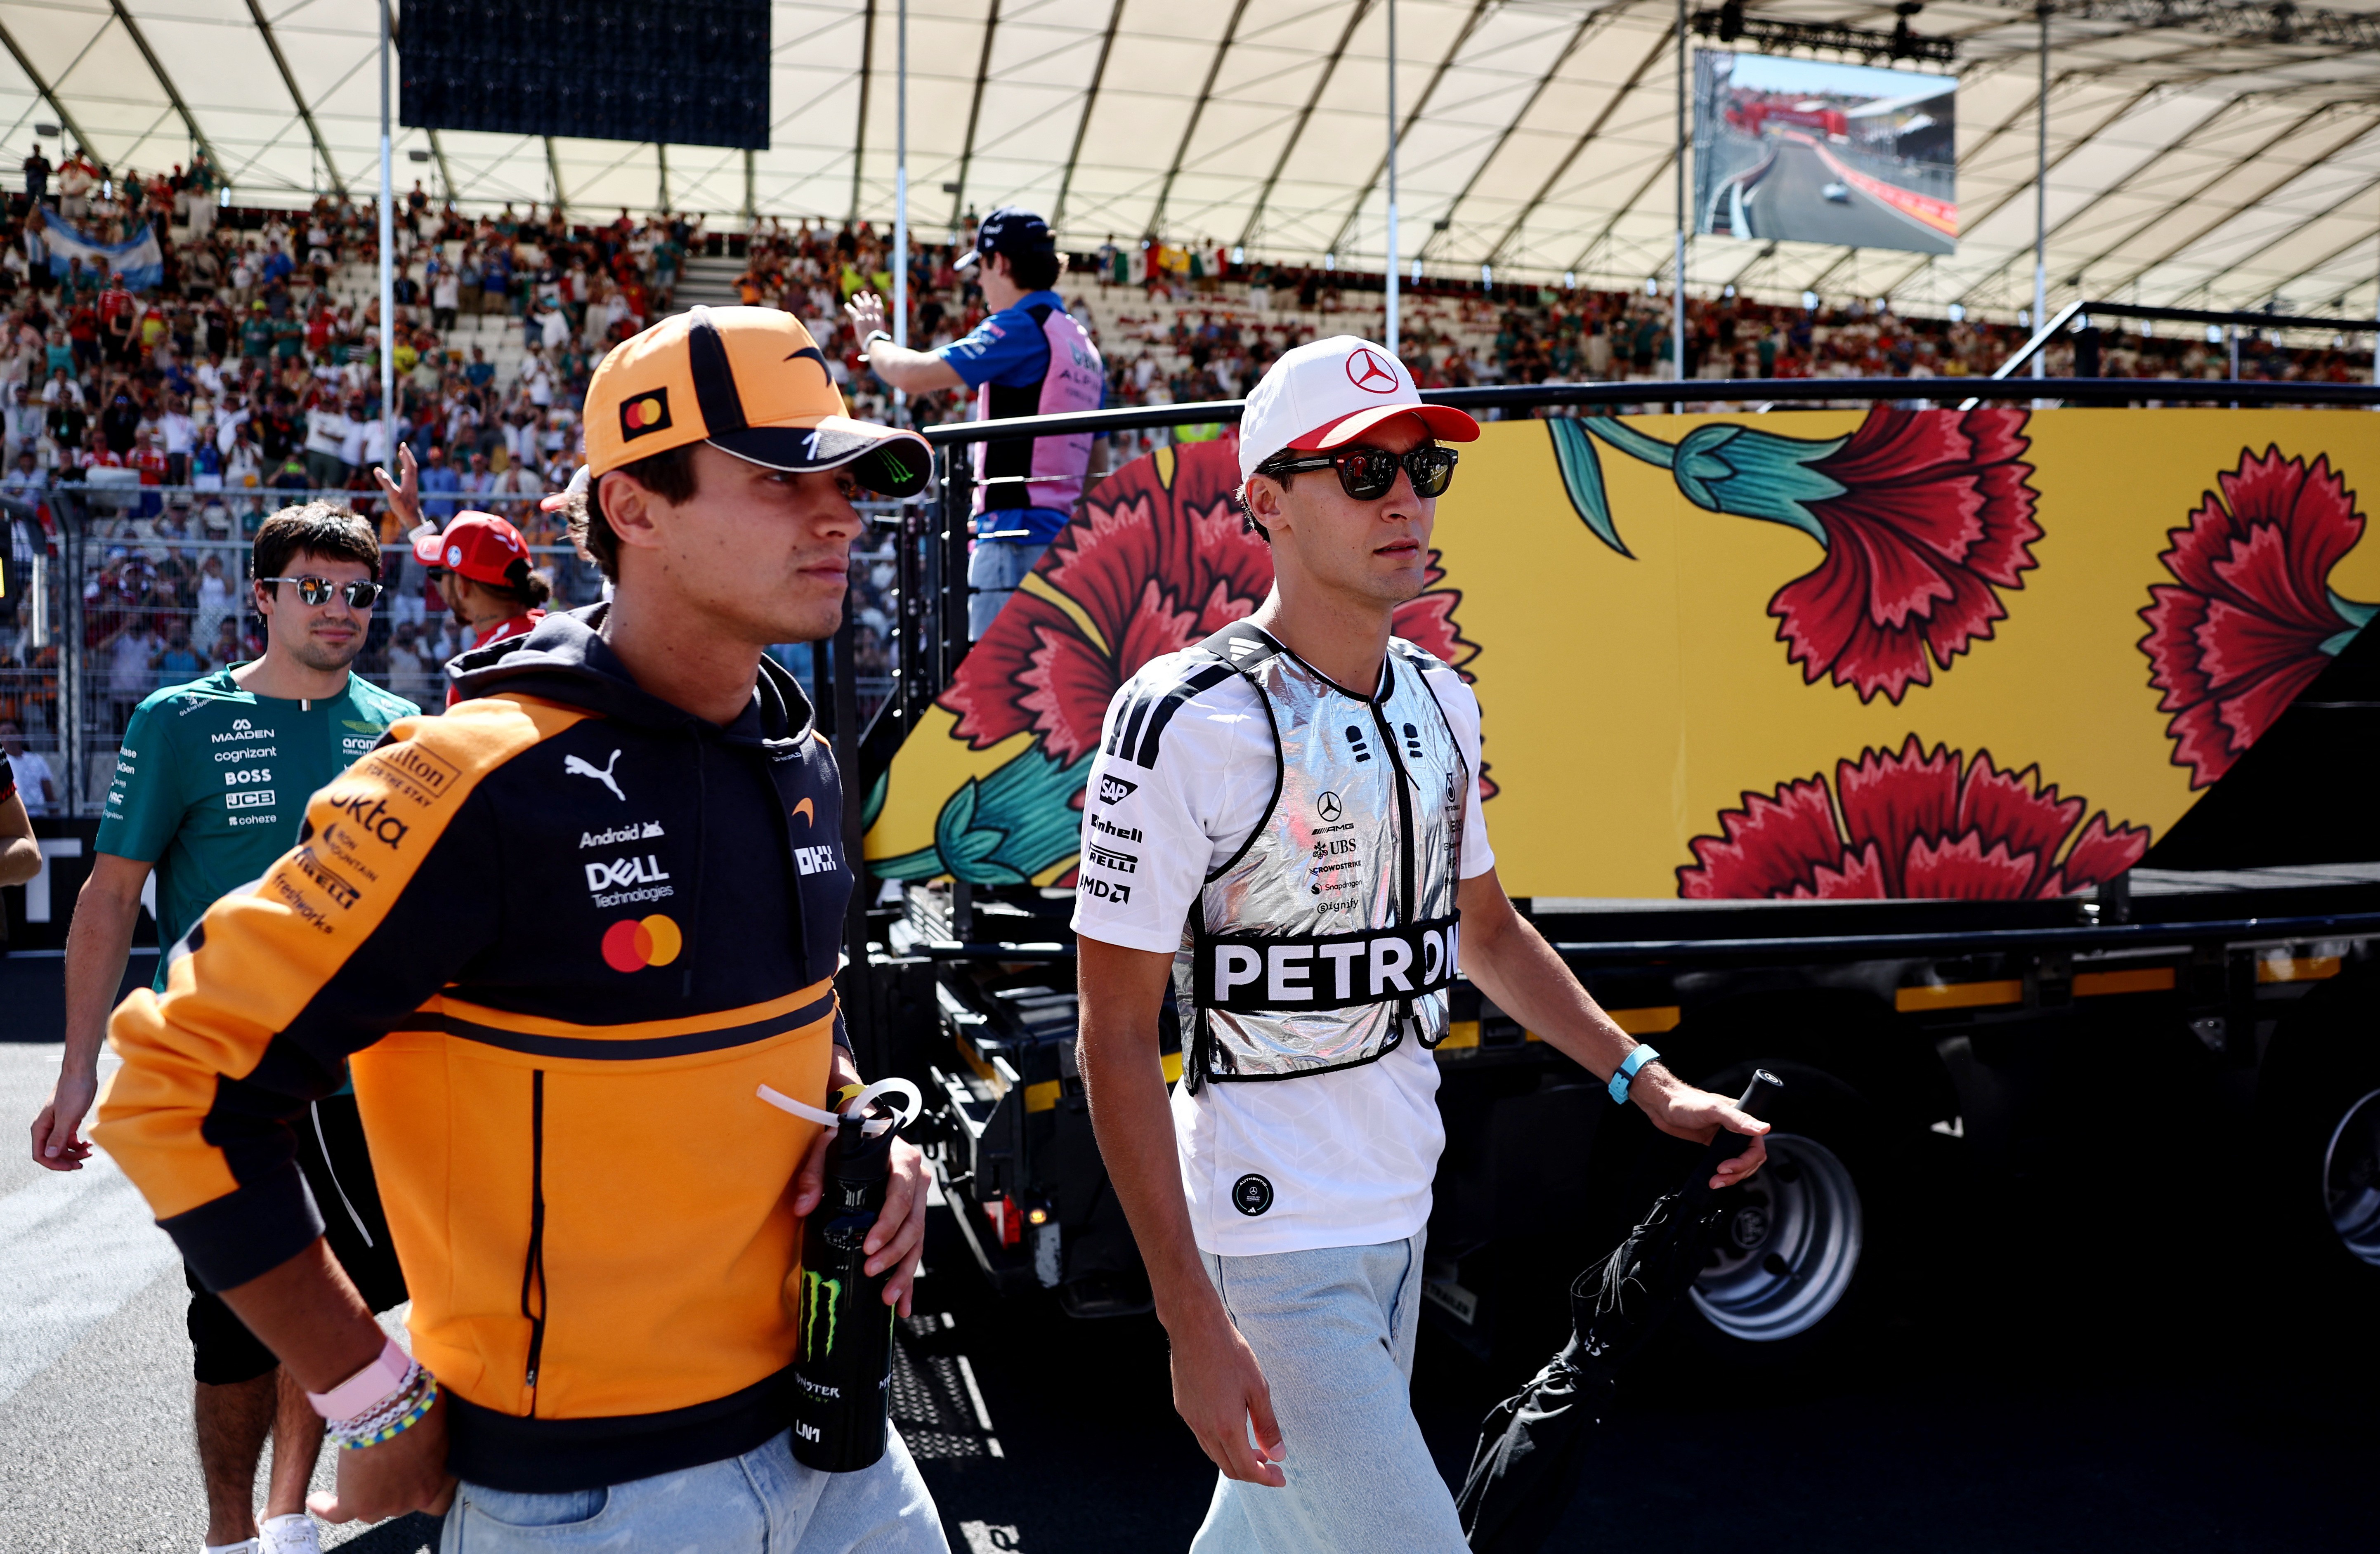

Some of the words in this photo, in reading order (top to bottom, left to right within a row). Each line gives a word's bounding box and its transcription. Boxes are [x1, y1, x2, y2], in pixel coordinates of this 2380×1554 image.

[211, 729, 275, 743] MAADEN
[214, 746, 277, 763] cognizant
[225, 768, 272, 786] BOSS
[228, 792, 274, 806] JCB
[404, 785, 432, 808] STAY
[1101, 779, 1127, 802] SAP
[238, 814, 277, 825] cohere
[330, 790, 410, 850] okta
[1091, 813, 1143, 844] Einhell
[579, 823, 640, 849] Android
[1329, 838, 1356, 855] UBS
[794, 845, 837, 876] OKX
[1088, 841, 1138, 874] PRELLI
[1313, 860, 1361, 873] CROWDSTRIKE
[585, 854, 670, 892] DELL
[591, 883, 674, 908] Technologies
[1080, 873, 1109, 898] AMD
[1325, 880, 1362, 891] Snapdragon
[272, 872, 335, 935] freshworks
[1240, 1177, 1268, 1187] AUTHENTIC
[795, 1371, 840, 1398] ONSTER
[796, 1419, 820, 1443] LN1
